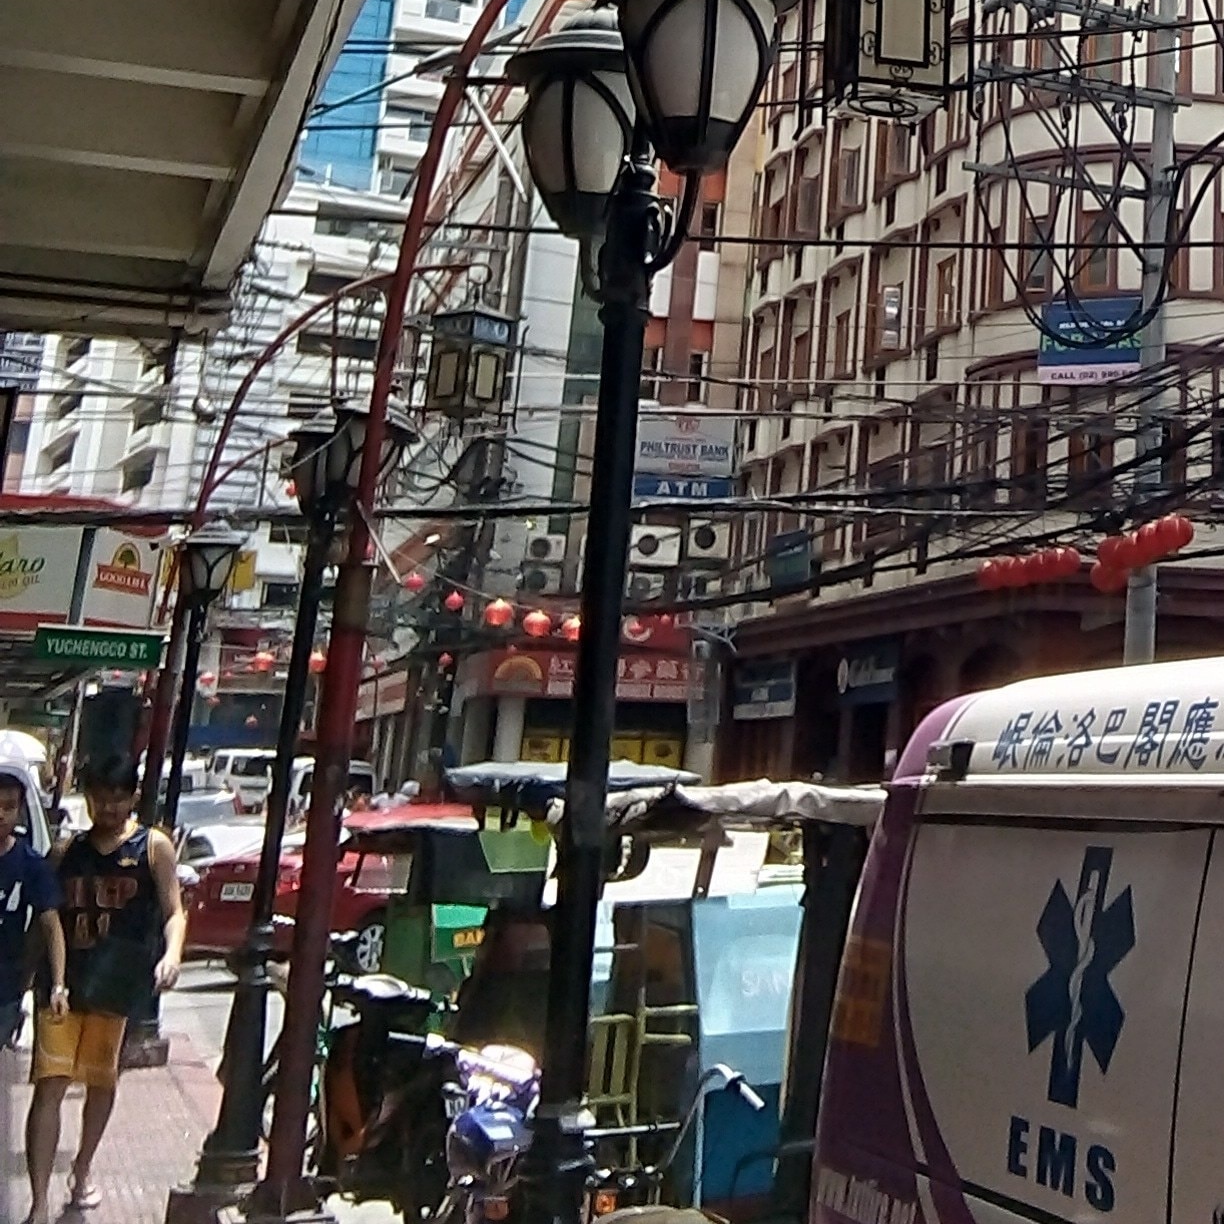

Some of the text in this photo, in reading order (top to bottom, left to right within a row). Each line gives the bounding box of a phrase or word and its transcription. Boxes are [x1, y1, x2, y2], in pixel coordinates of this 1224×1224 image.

[1050, 371, 1076, 381] CALL
[701, 444, 730, 457] BANK
[656, 480, 708, 497] ATM
[46, 637, 127, 660] YUCHENGCO
[1007, 1115, 1116, 1213] EMS
